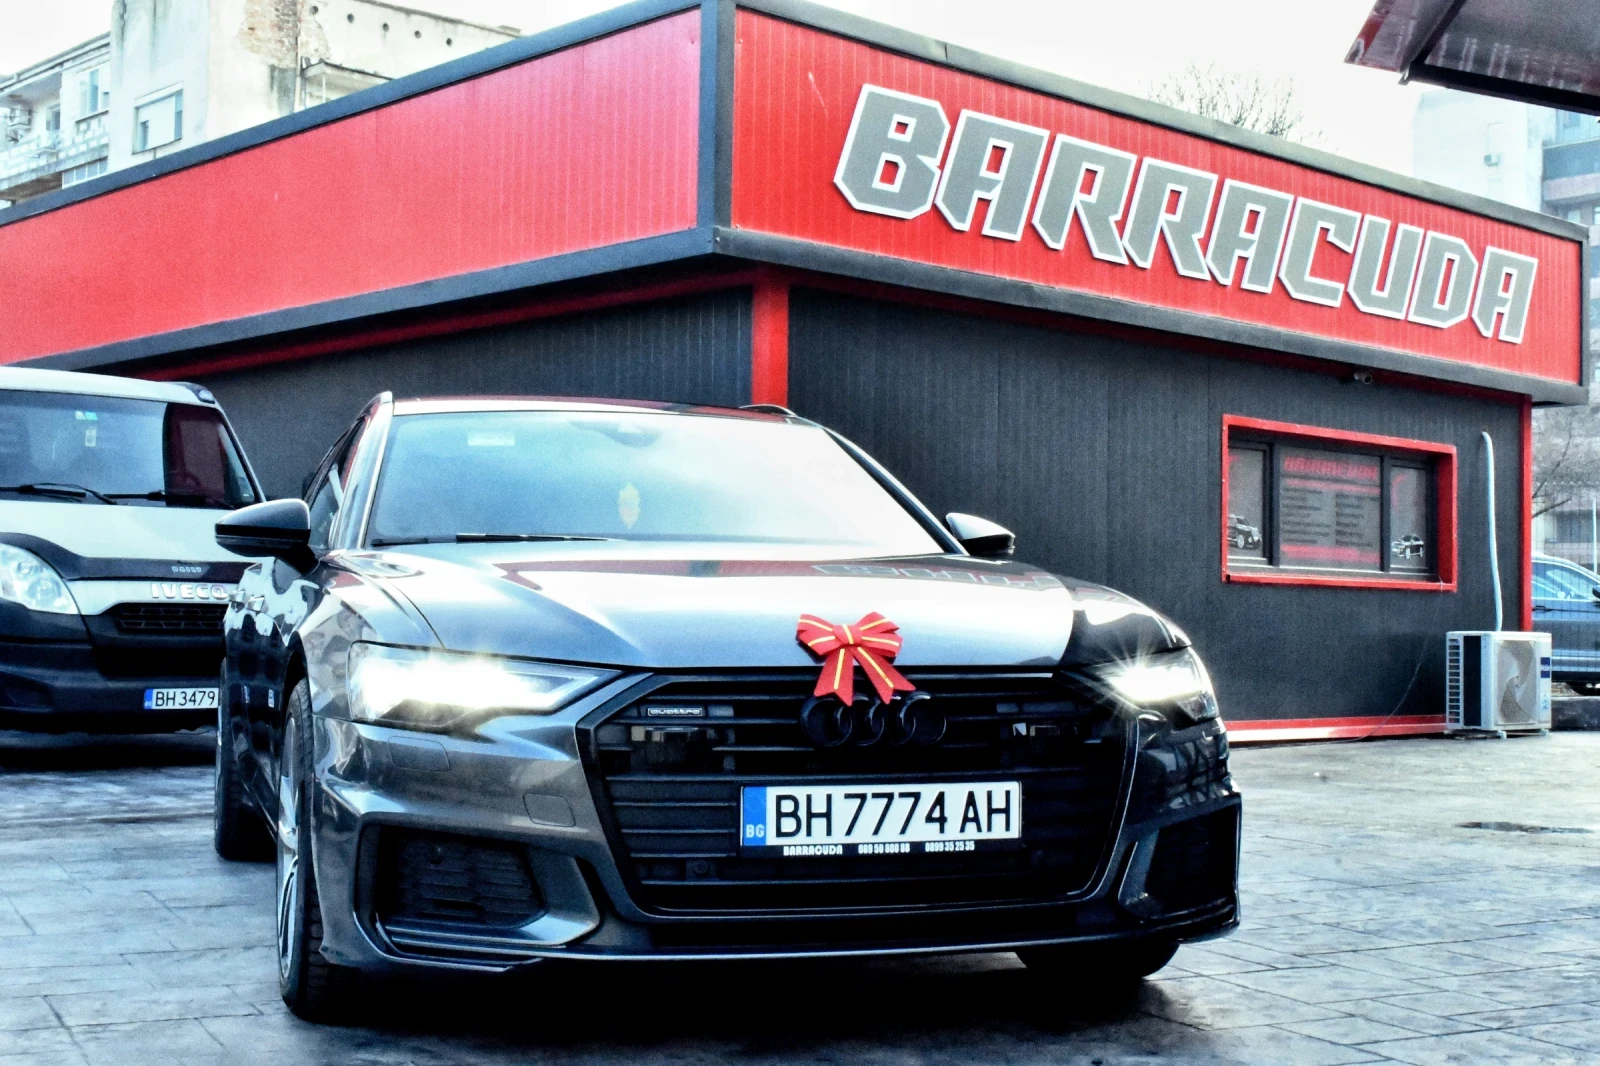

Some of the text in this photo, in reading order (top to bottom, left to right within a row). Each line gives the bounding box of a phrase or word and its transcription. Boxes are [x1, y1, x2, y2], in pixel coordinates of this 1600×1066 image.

[833, 83, 1539, 344] BARRACUDA
[150, 582, 227, 600] IVECO
[155, 690, 216, 707] BH 3479
[775, 789, 1011, 838] BH 7774 AH
[745, 823, 765, 838] BG
[783, 844, 843, 856] BARRACUDA
